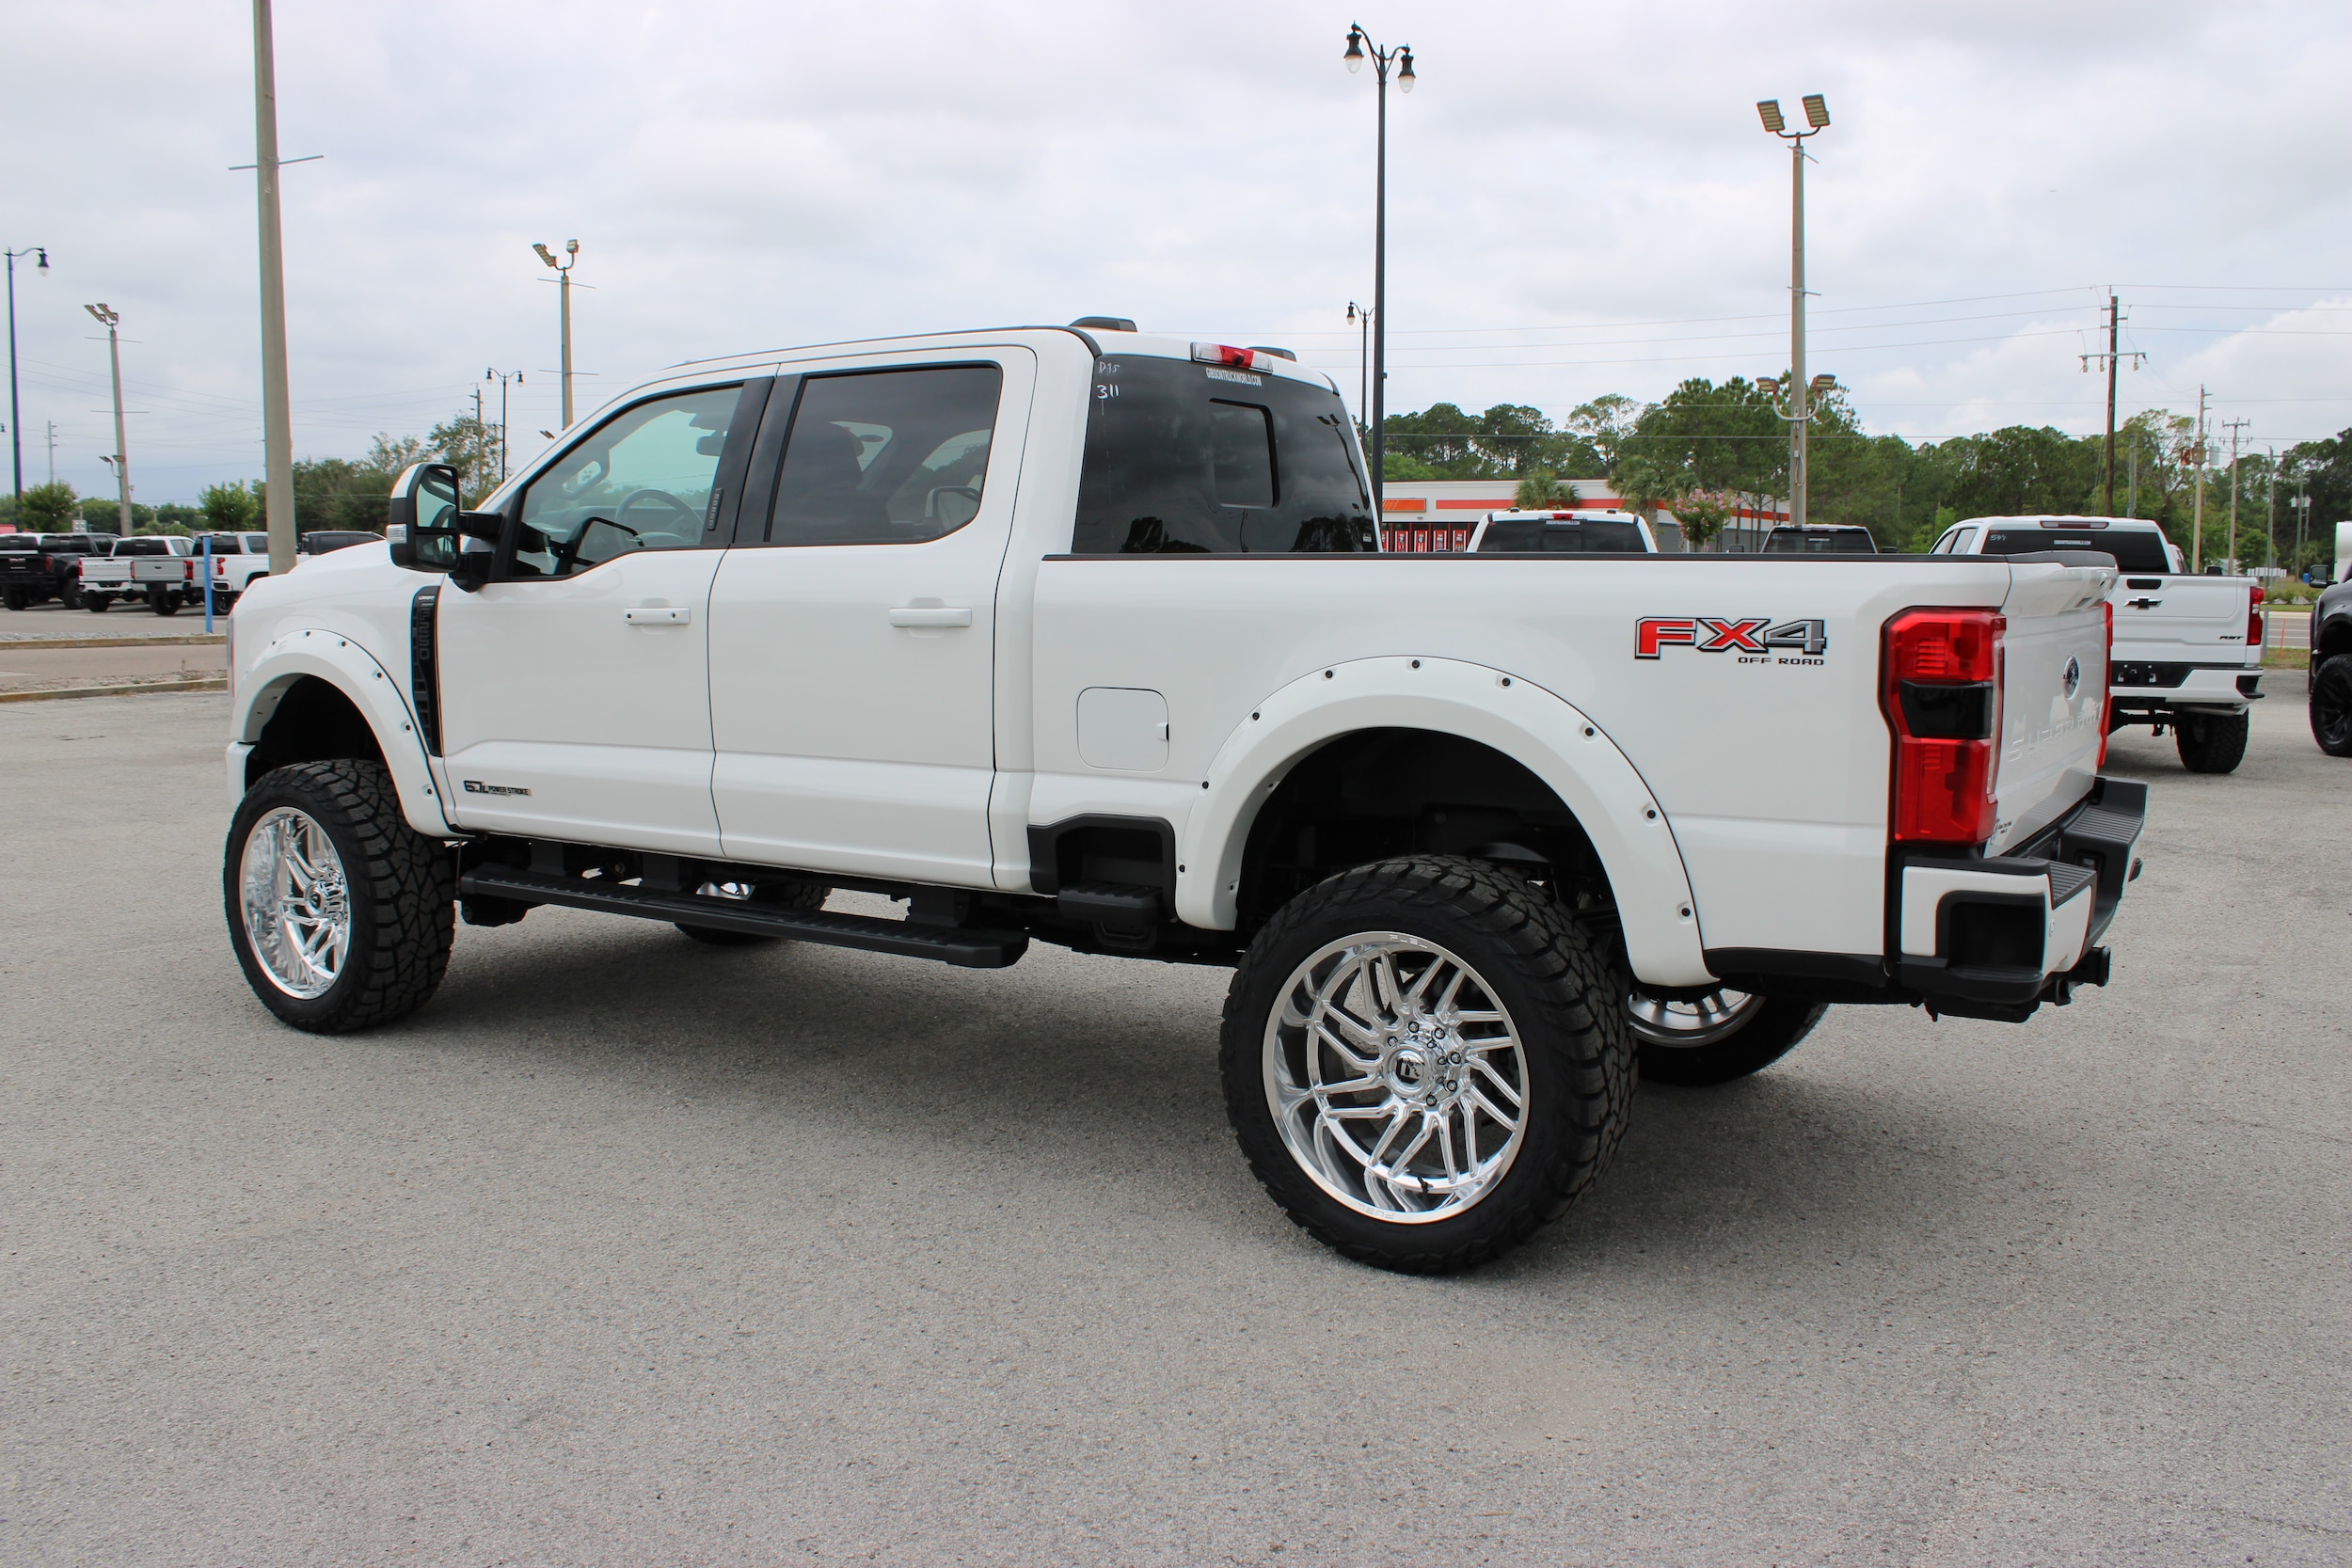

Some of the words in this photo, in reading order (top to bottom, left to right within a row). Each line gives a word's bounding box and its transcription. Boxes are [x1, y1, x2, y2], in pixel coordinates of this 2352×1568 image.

[1097, 384, 1120, 400] 311
[1634, 616, 1827, 659] FX4
[1778, 657, 1824, 666] ROAD
